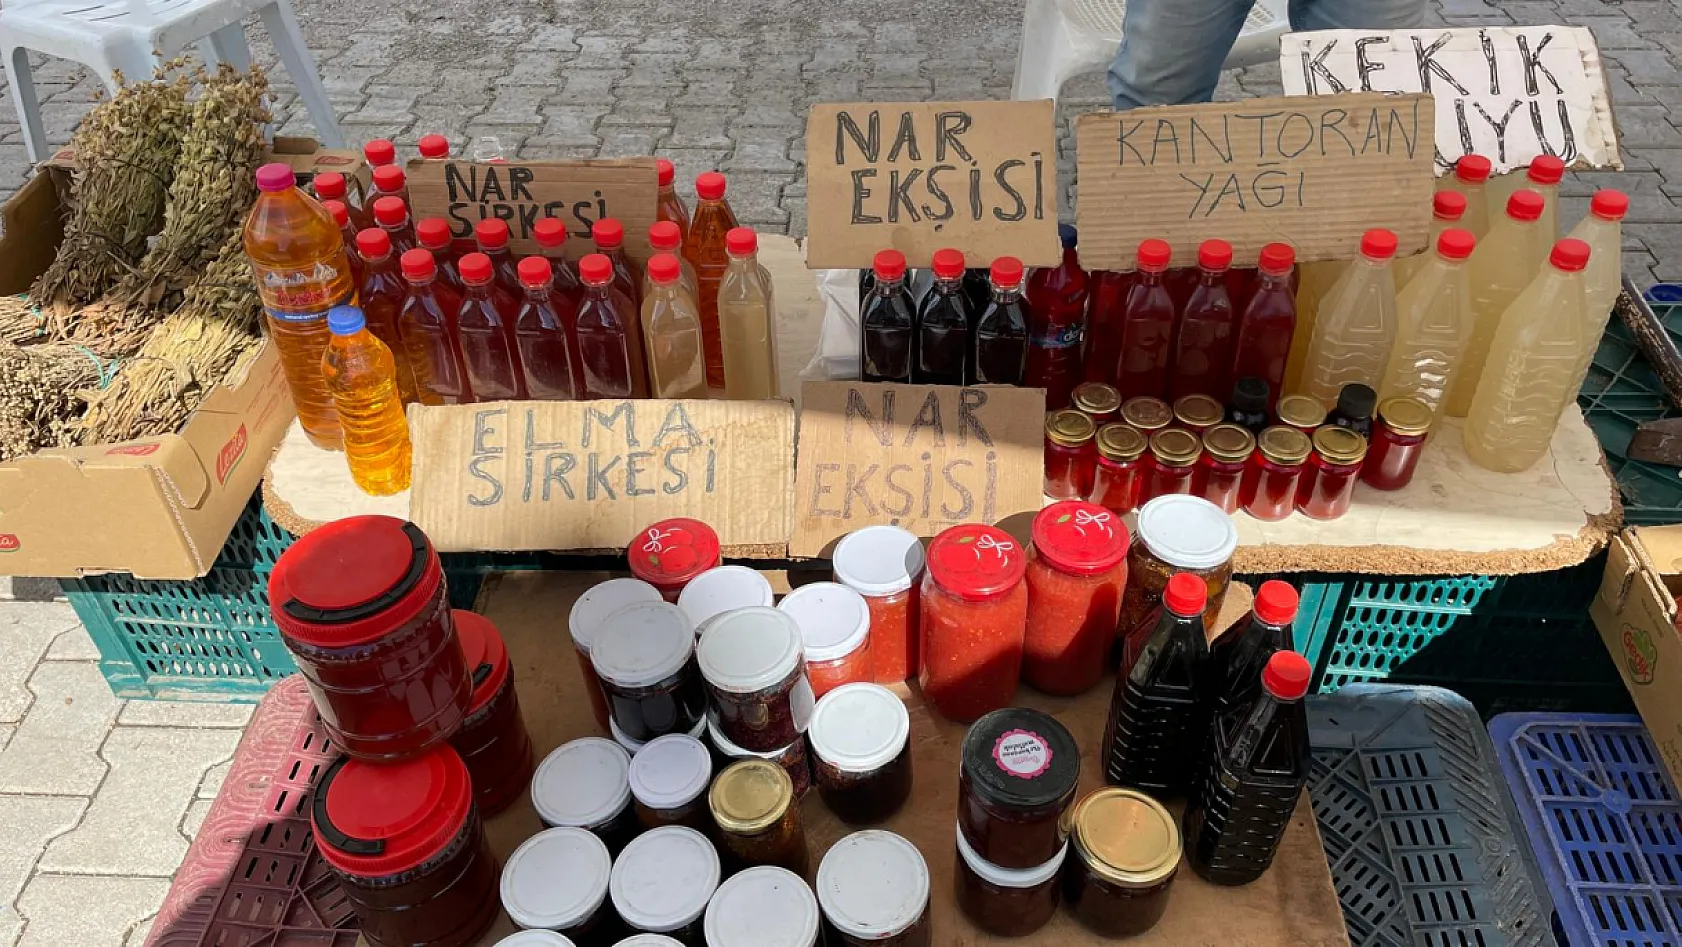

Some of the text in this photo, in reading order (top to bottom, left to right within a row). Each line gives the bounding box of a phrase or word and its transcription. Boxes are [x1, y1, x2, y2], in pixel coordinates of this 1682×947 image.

[835, 109, 973, 165] NAR
[1116, 98, 1419, 167] KANTORAN
[444, 162, 534, 203] NAR
[851, 152, 1044, 232] EKŞİSİ
[473, 400, 704, 456] ELMA
[844, 388, 994, 448] NAR
[467, 438, 716, 506] SİRKESİ
